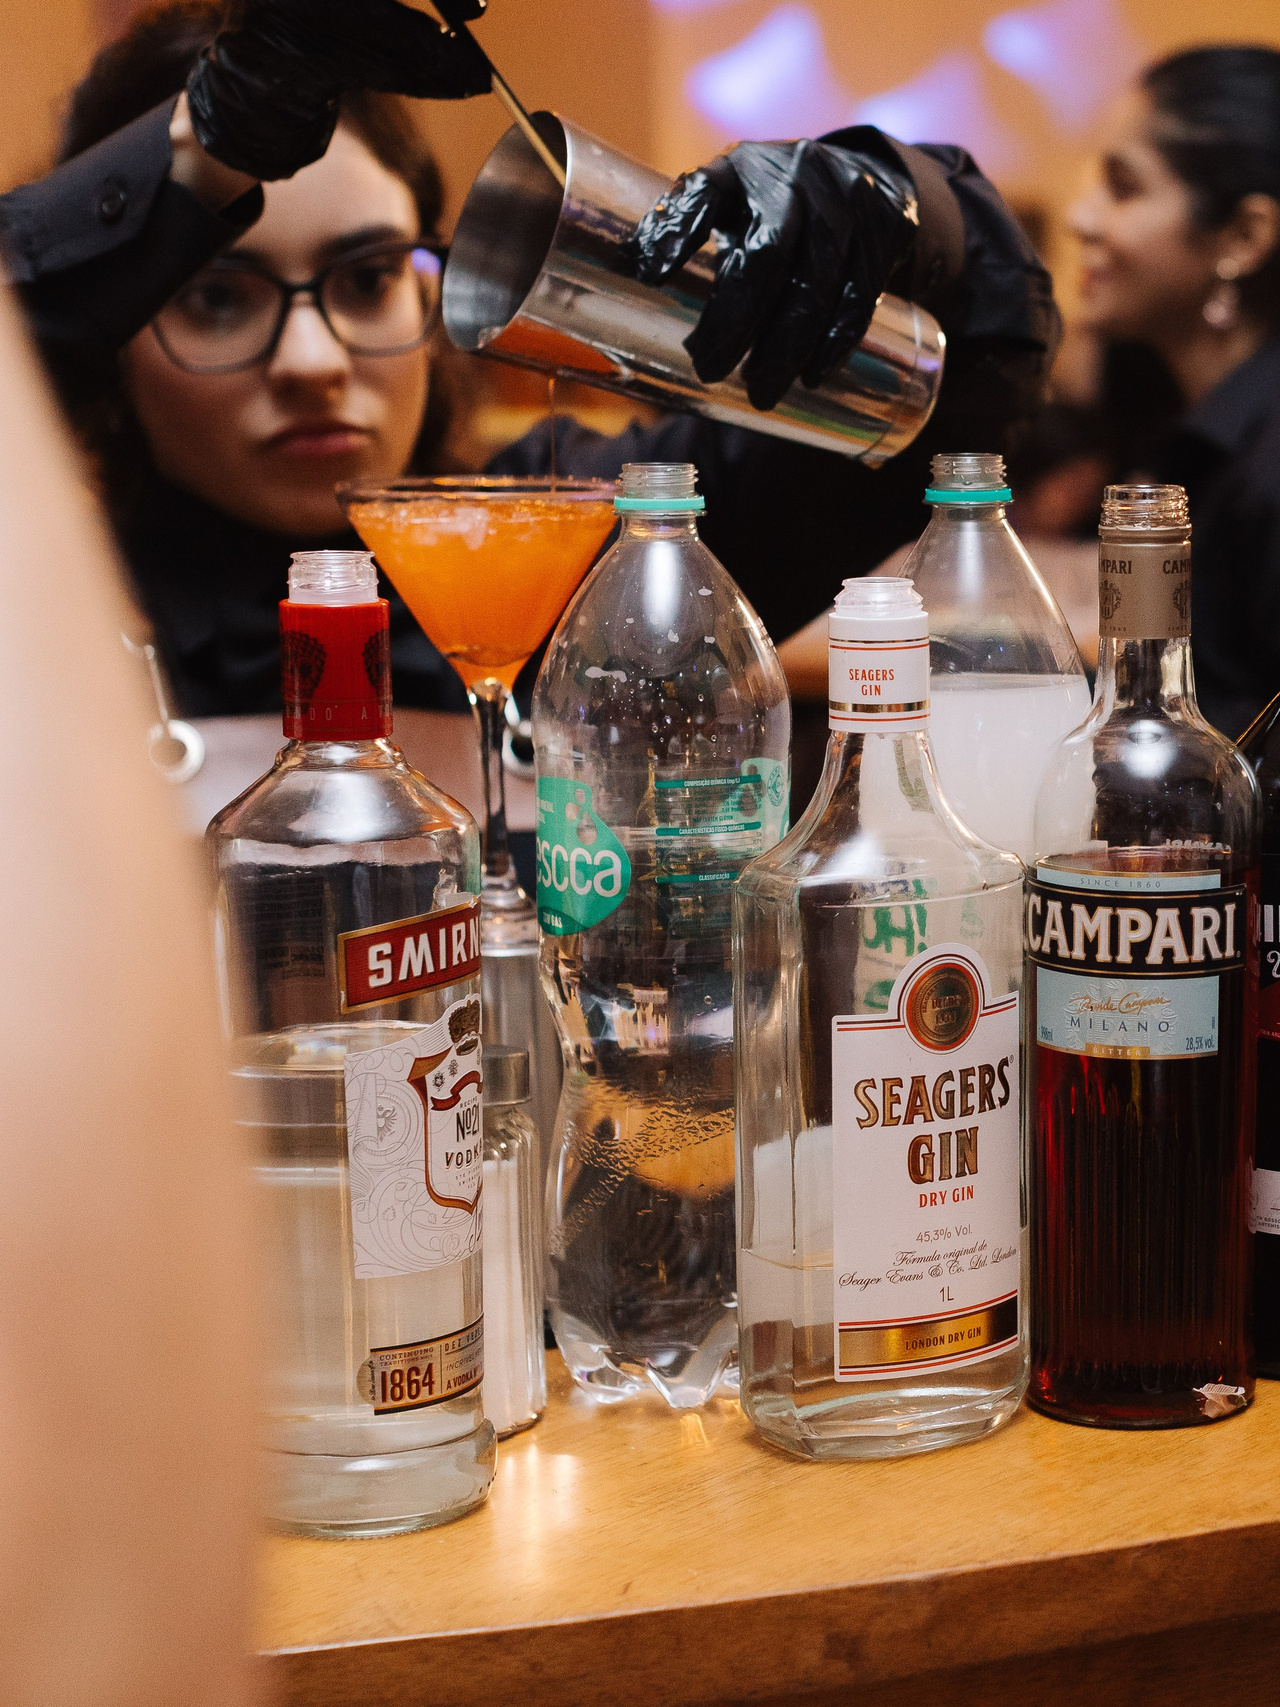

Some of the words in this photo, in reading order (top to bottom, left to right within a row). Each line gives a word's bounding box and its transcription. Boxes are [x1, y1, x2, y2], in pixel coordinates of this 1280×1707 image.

[849, 668, 895, 681] SEAGERS
[861, 684, 881, 696] GIN
[1080, 877, 1119, 888] SINCE
[1129, 880, 1161, 889] 1860
[1028, 892, 1237, 965] CAMPARI
[1070, 1016, 1170, 1033] MILANO
[1093, 1046, 1142, 1057] BITTER
[854, 1056, 1010, 1130] SEAGERS
[908, 1126, 979, 1185] GIN
[919, 1190, 947, 1208] DRY
[952, 1185, 974, 1203] GIN
[916, 1227, 951, 1243] 45,3%
[955, 1223, 973, 1237] Vol.
[943, 1240, 978, 1263] original
[978, 1239, 988, 1251] de
[838, 1271, 882, 1291] Seager
[886, 1268, 924, 1284] Evans
[928, 1264, 943, 1278] &
[946, 1258, 965, 1275] Co.
[968, 1254, 988, 1270] Ltd.
[991, 1246, 1017, 1264] London
[939, 1286, 954, 1302] 1L
[905, 1334, 945, 1350] LONDON
[948, 1331, 965, 1344] DRY
[967, 1326, 981, 1340] GIN
[379, 1347, 434, 1361] CONTINUING
[381, 1363, 435, 1403] 1864
